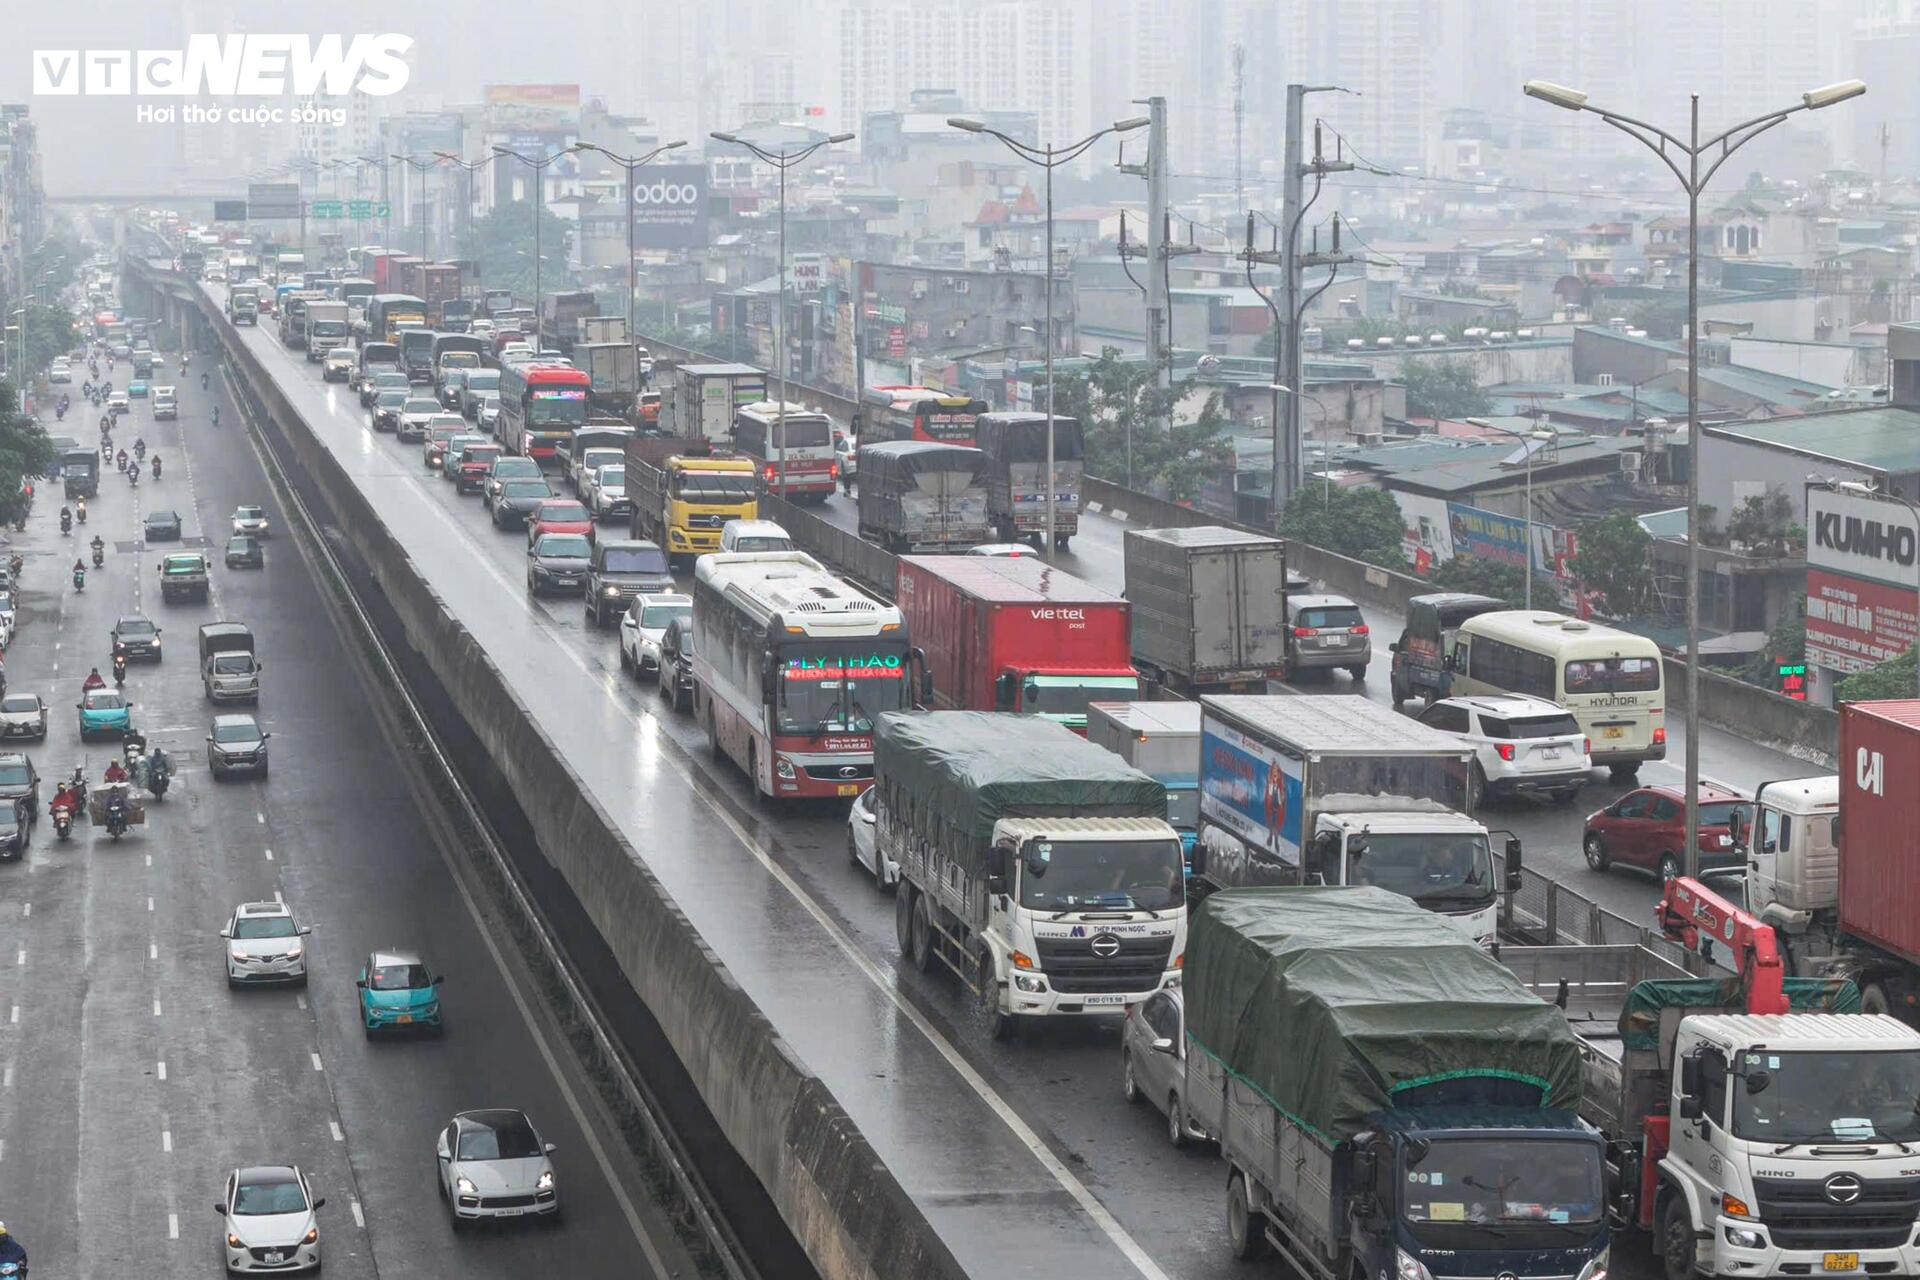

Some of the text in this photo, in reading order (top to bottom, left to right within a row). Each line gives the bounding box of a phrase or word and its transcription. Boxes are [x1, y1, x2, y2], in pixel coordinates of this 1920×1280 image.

[634, 178, 697, 204] odoo
[1816, 510, 1915, 566] KUMHO
[1031, 608, 1085, 619] viettel
[1590, 696, 1638, 706] HYUNDAI
